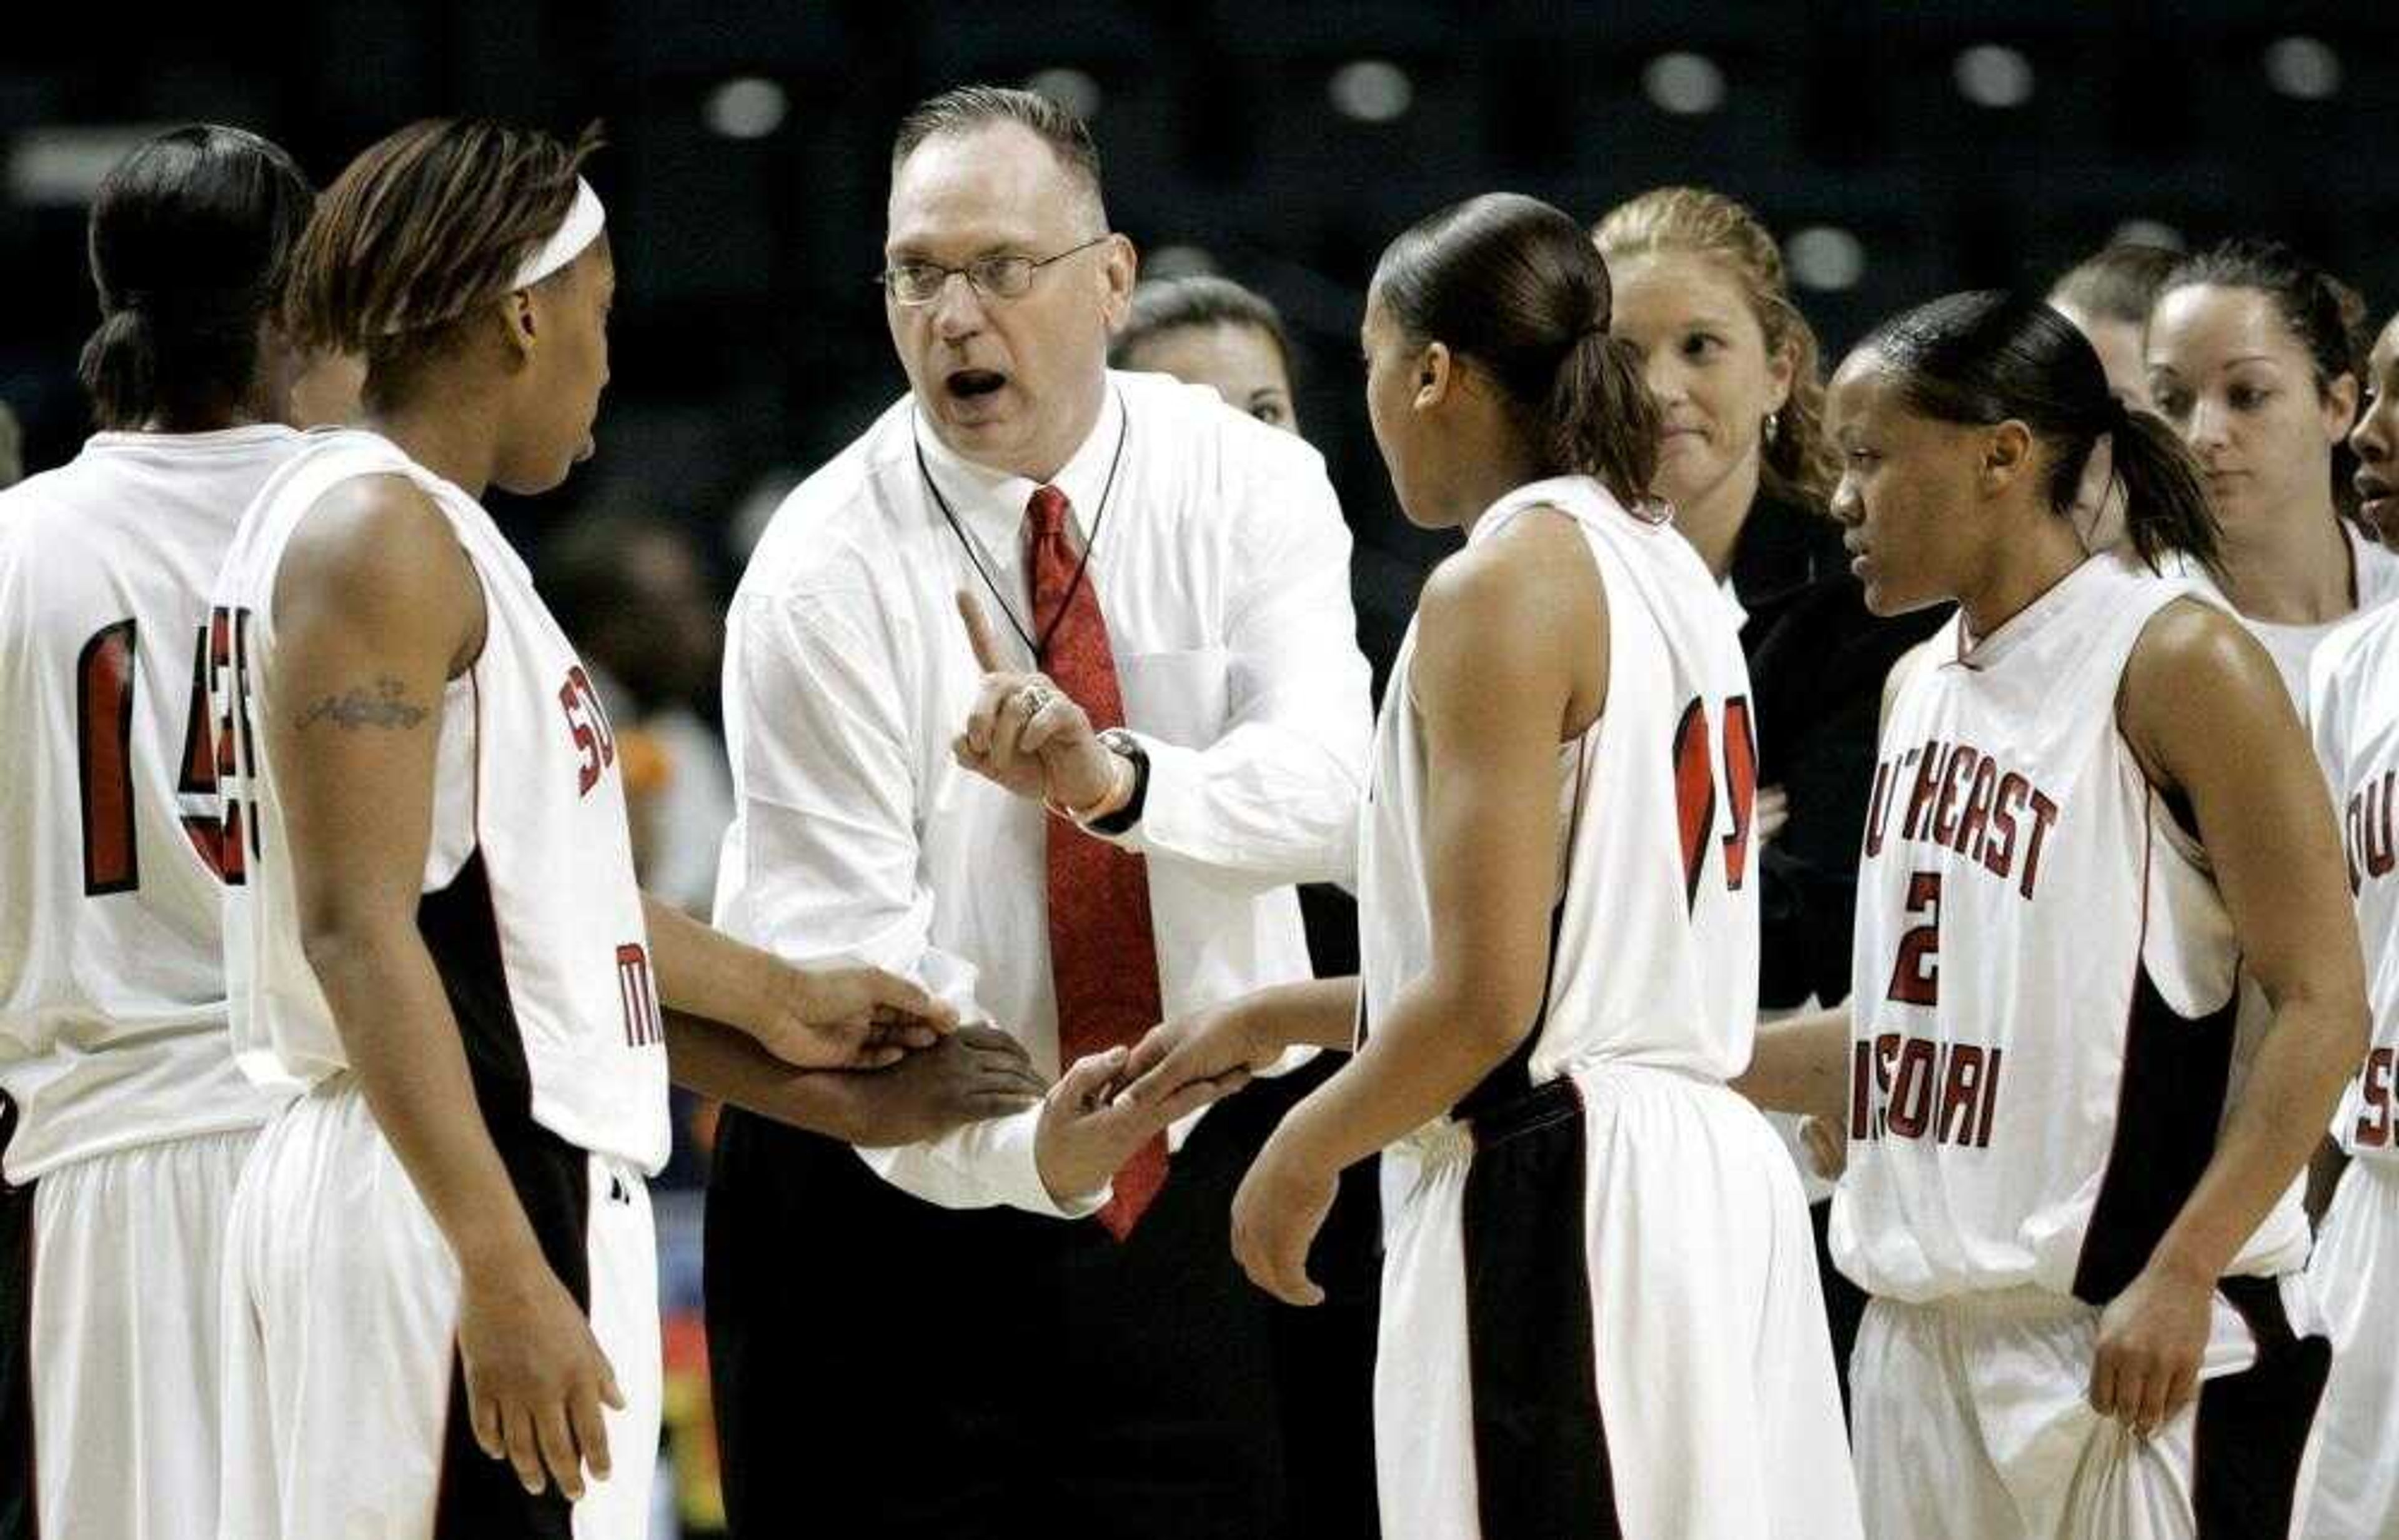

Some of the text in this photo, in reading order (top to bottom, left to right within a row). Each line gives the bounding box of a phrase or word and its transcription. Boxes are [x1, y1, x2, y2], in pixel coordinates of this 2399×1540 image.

[1865, 740, 2059, 900] UHEAST
[1886, 872, 1942, 1006] 2
[2355, 1047, 2399, 1148] S
